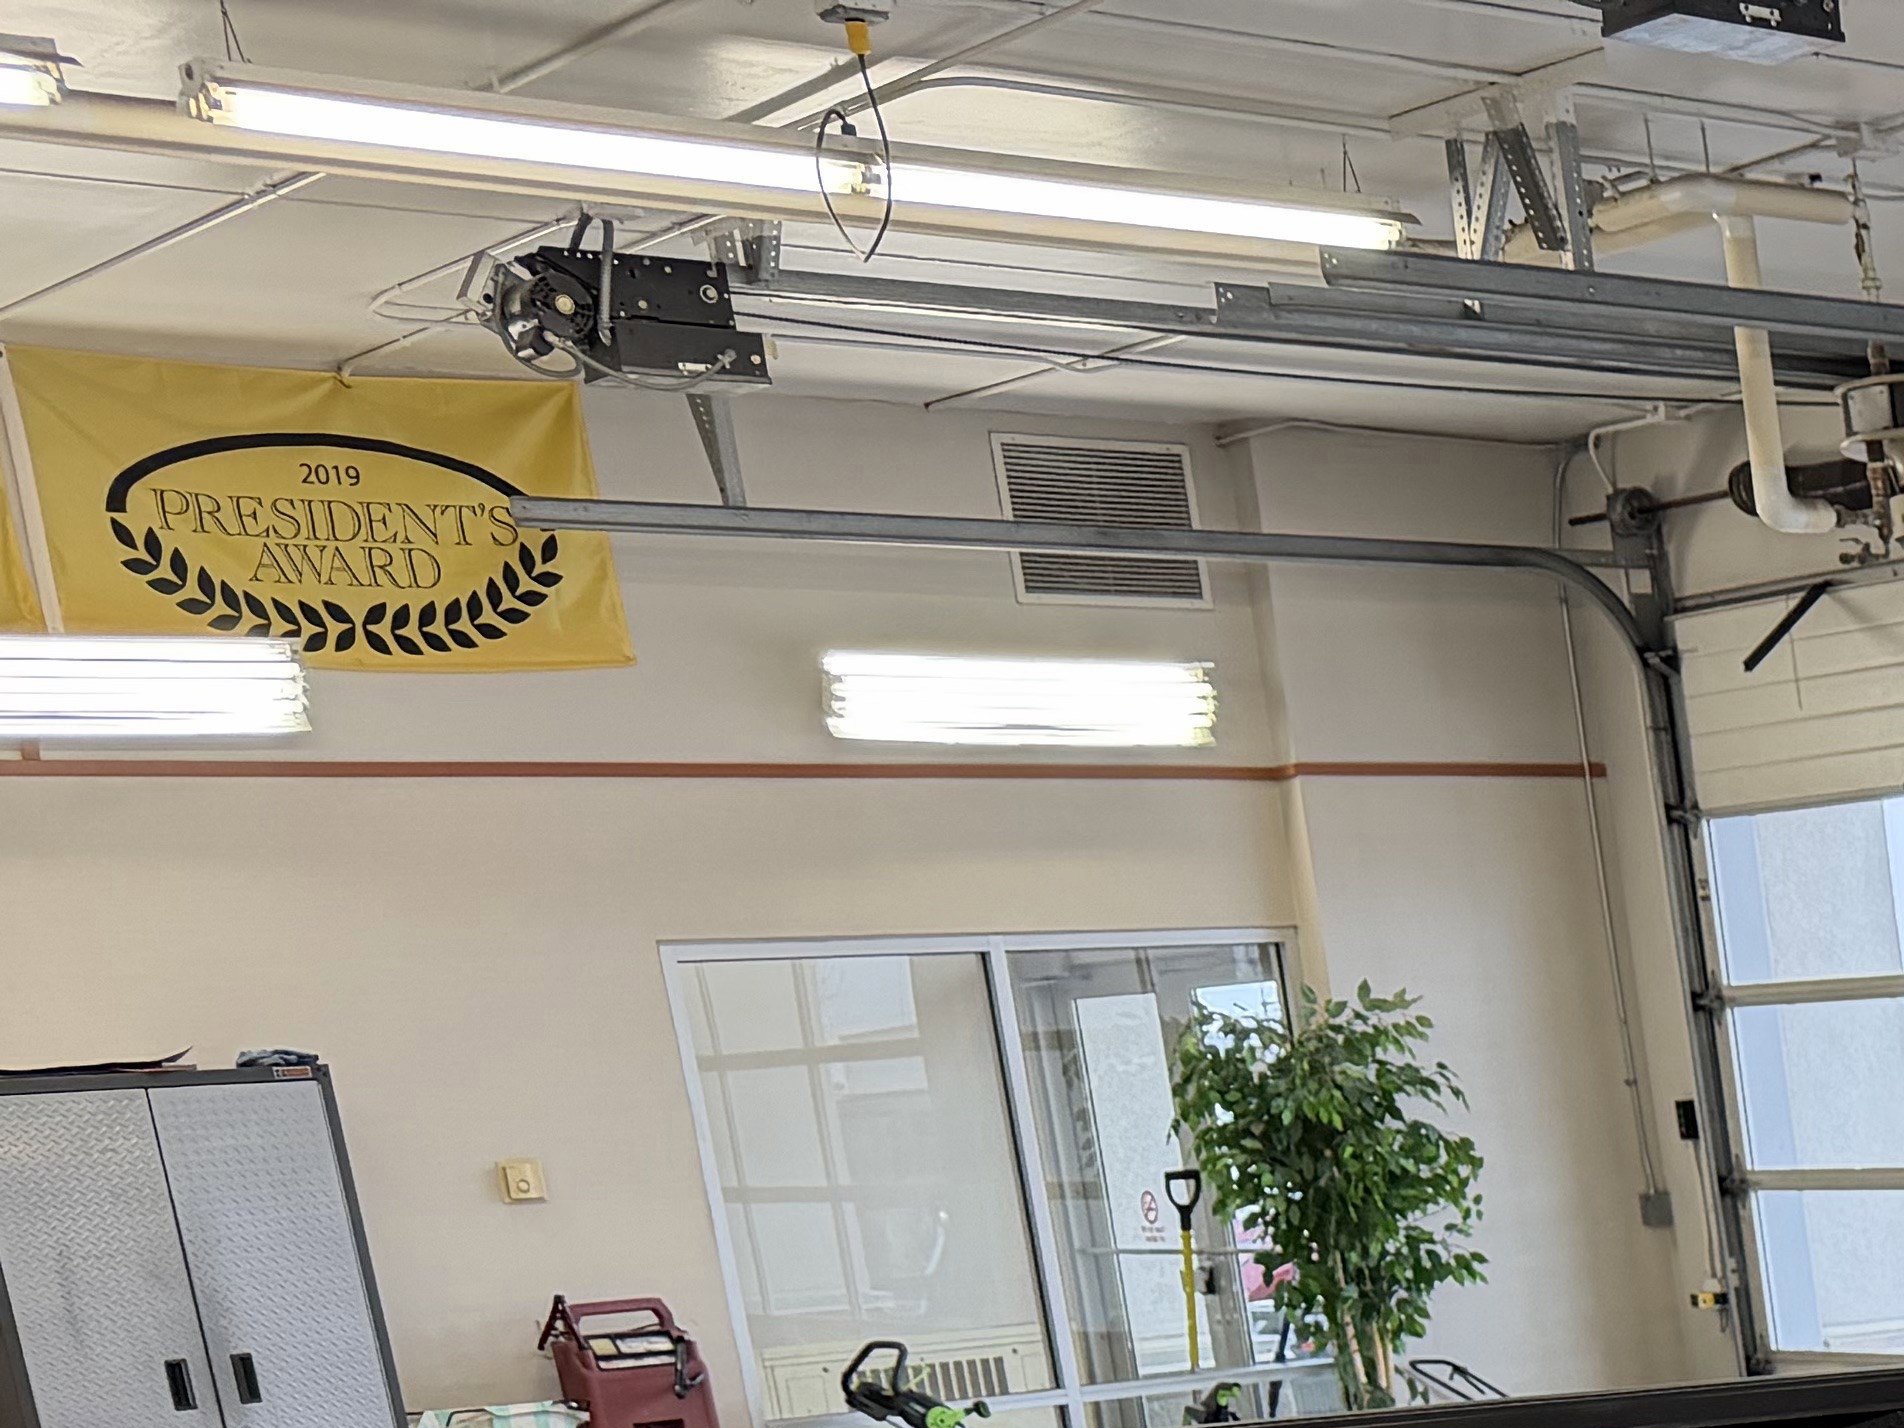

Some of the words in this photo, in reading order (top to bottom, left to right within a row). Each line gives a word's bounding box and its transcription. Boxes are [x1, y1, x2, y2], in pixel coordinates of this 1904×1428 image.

[299, 462, 361, 488] 2019
[150, 488, 519, 547] PRESIDENT'S
[248, 542, 442, 589] AWARD
